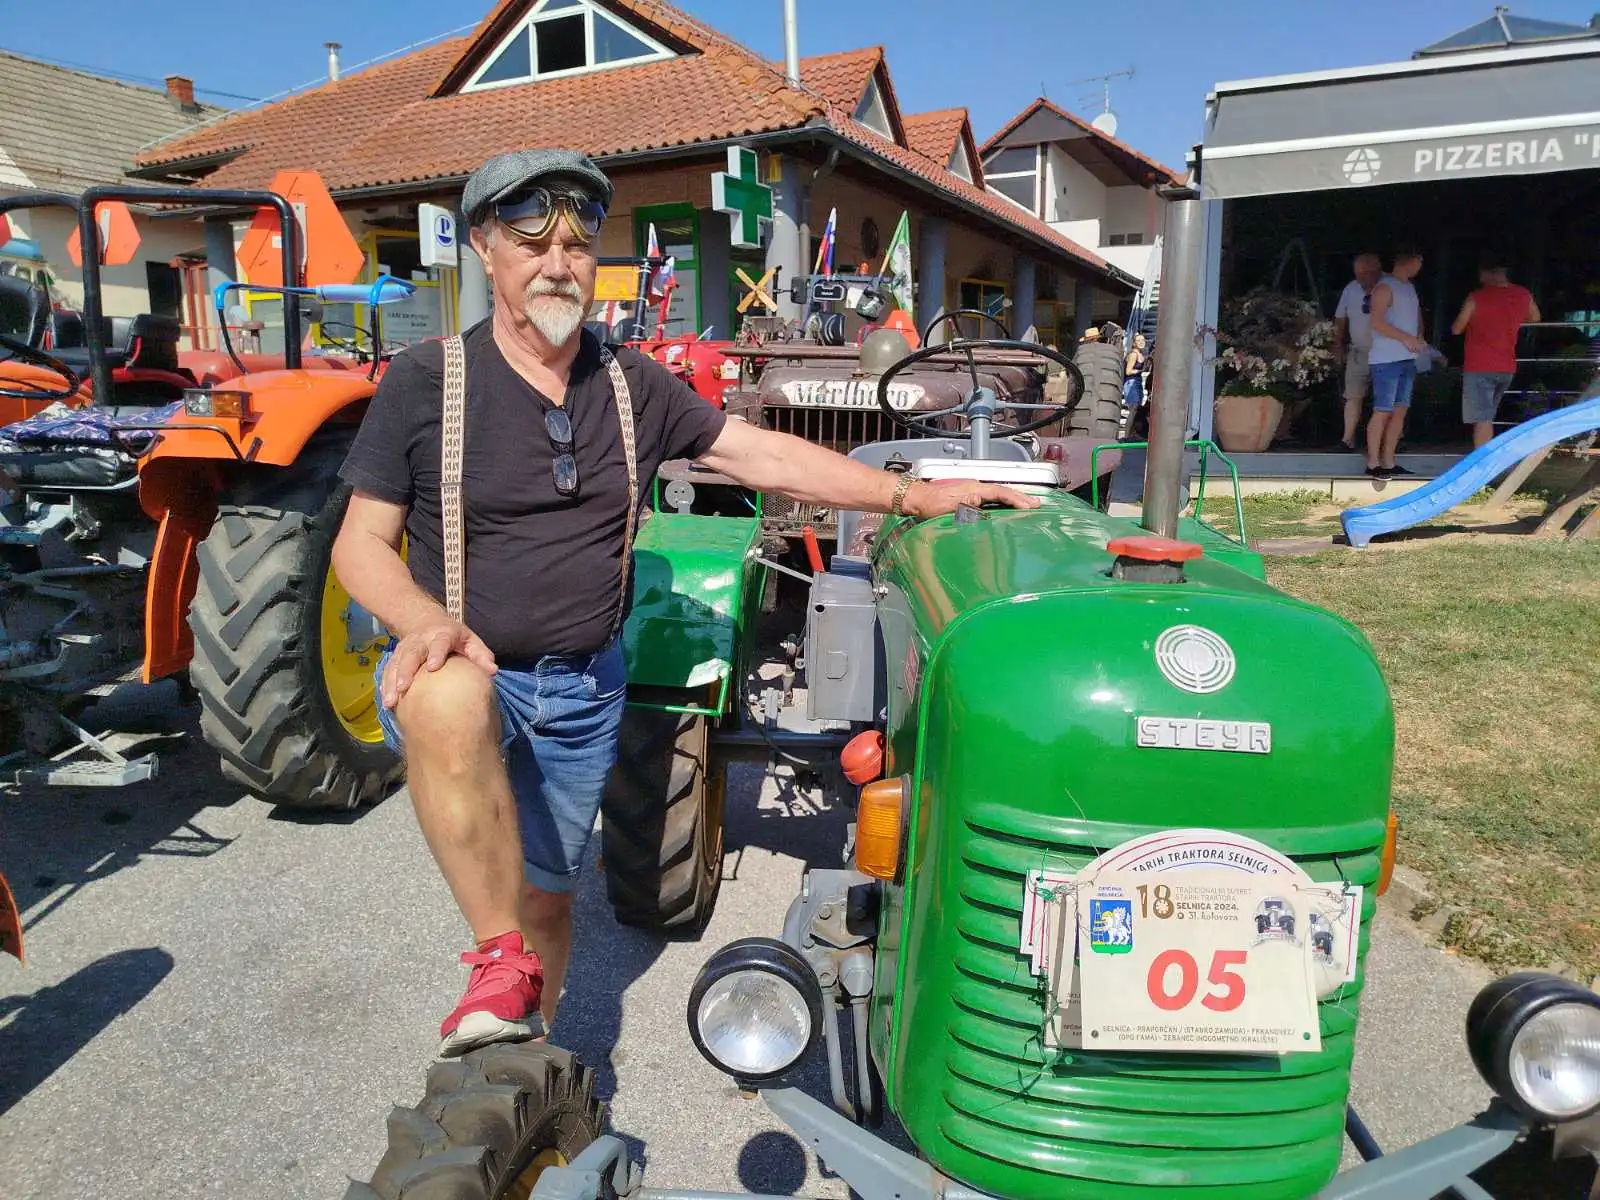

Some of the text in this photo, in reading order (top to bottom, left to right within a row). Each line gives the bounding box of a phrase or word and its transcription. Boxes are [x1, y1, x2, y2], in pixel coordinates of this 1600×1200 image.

[1414, 138, 1564, 173] PIZZERIA
[1140, 720, 1268, 751] STEYR
[1168, 849, 1224, 861] TRAKTORA
[1228, 854, 1268, 874] SELNICA
[1136, 884, 1174, 919] 18
[1176, 902, 1212, 910] SELNICA
[1146, 949, 1249, 1012] 05
